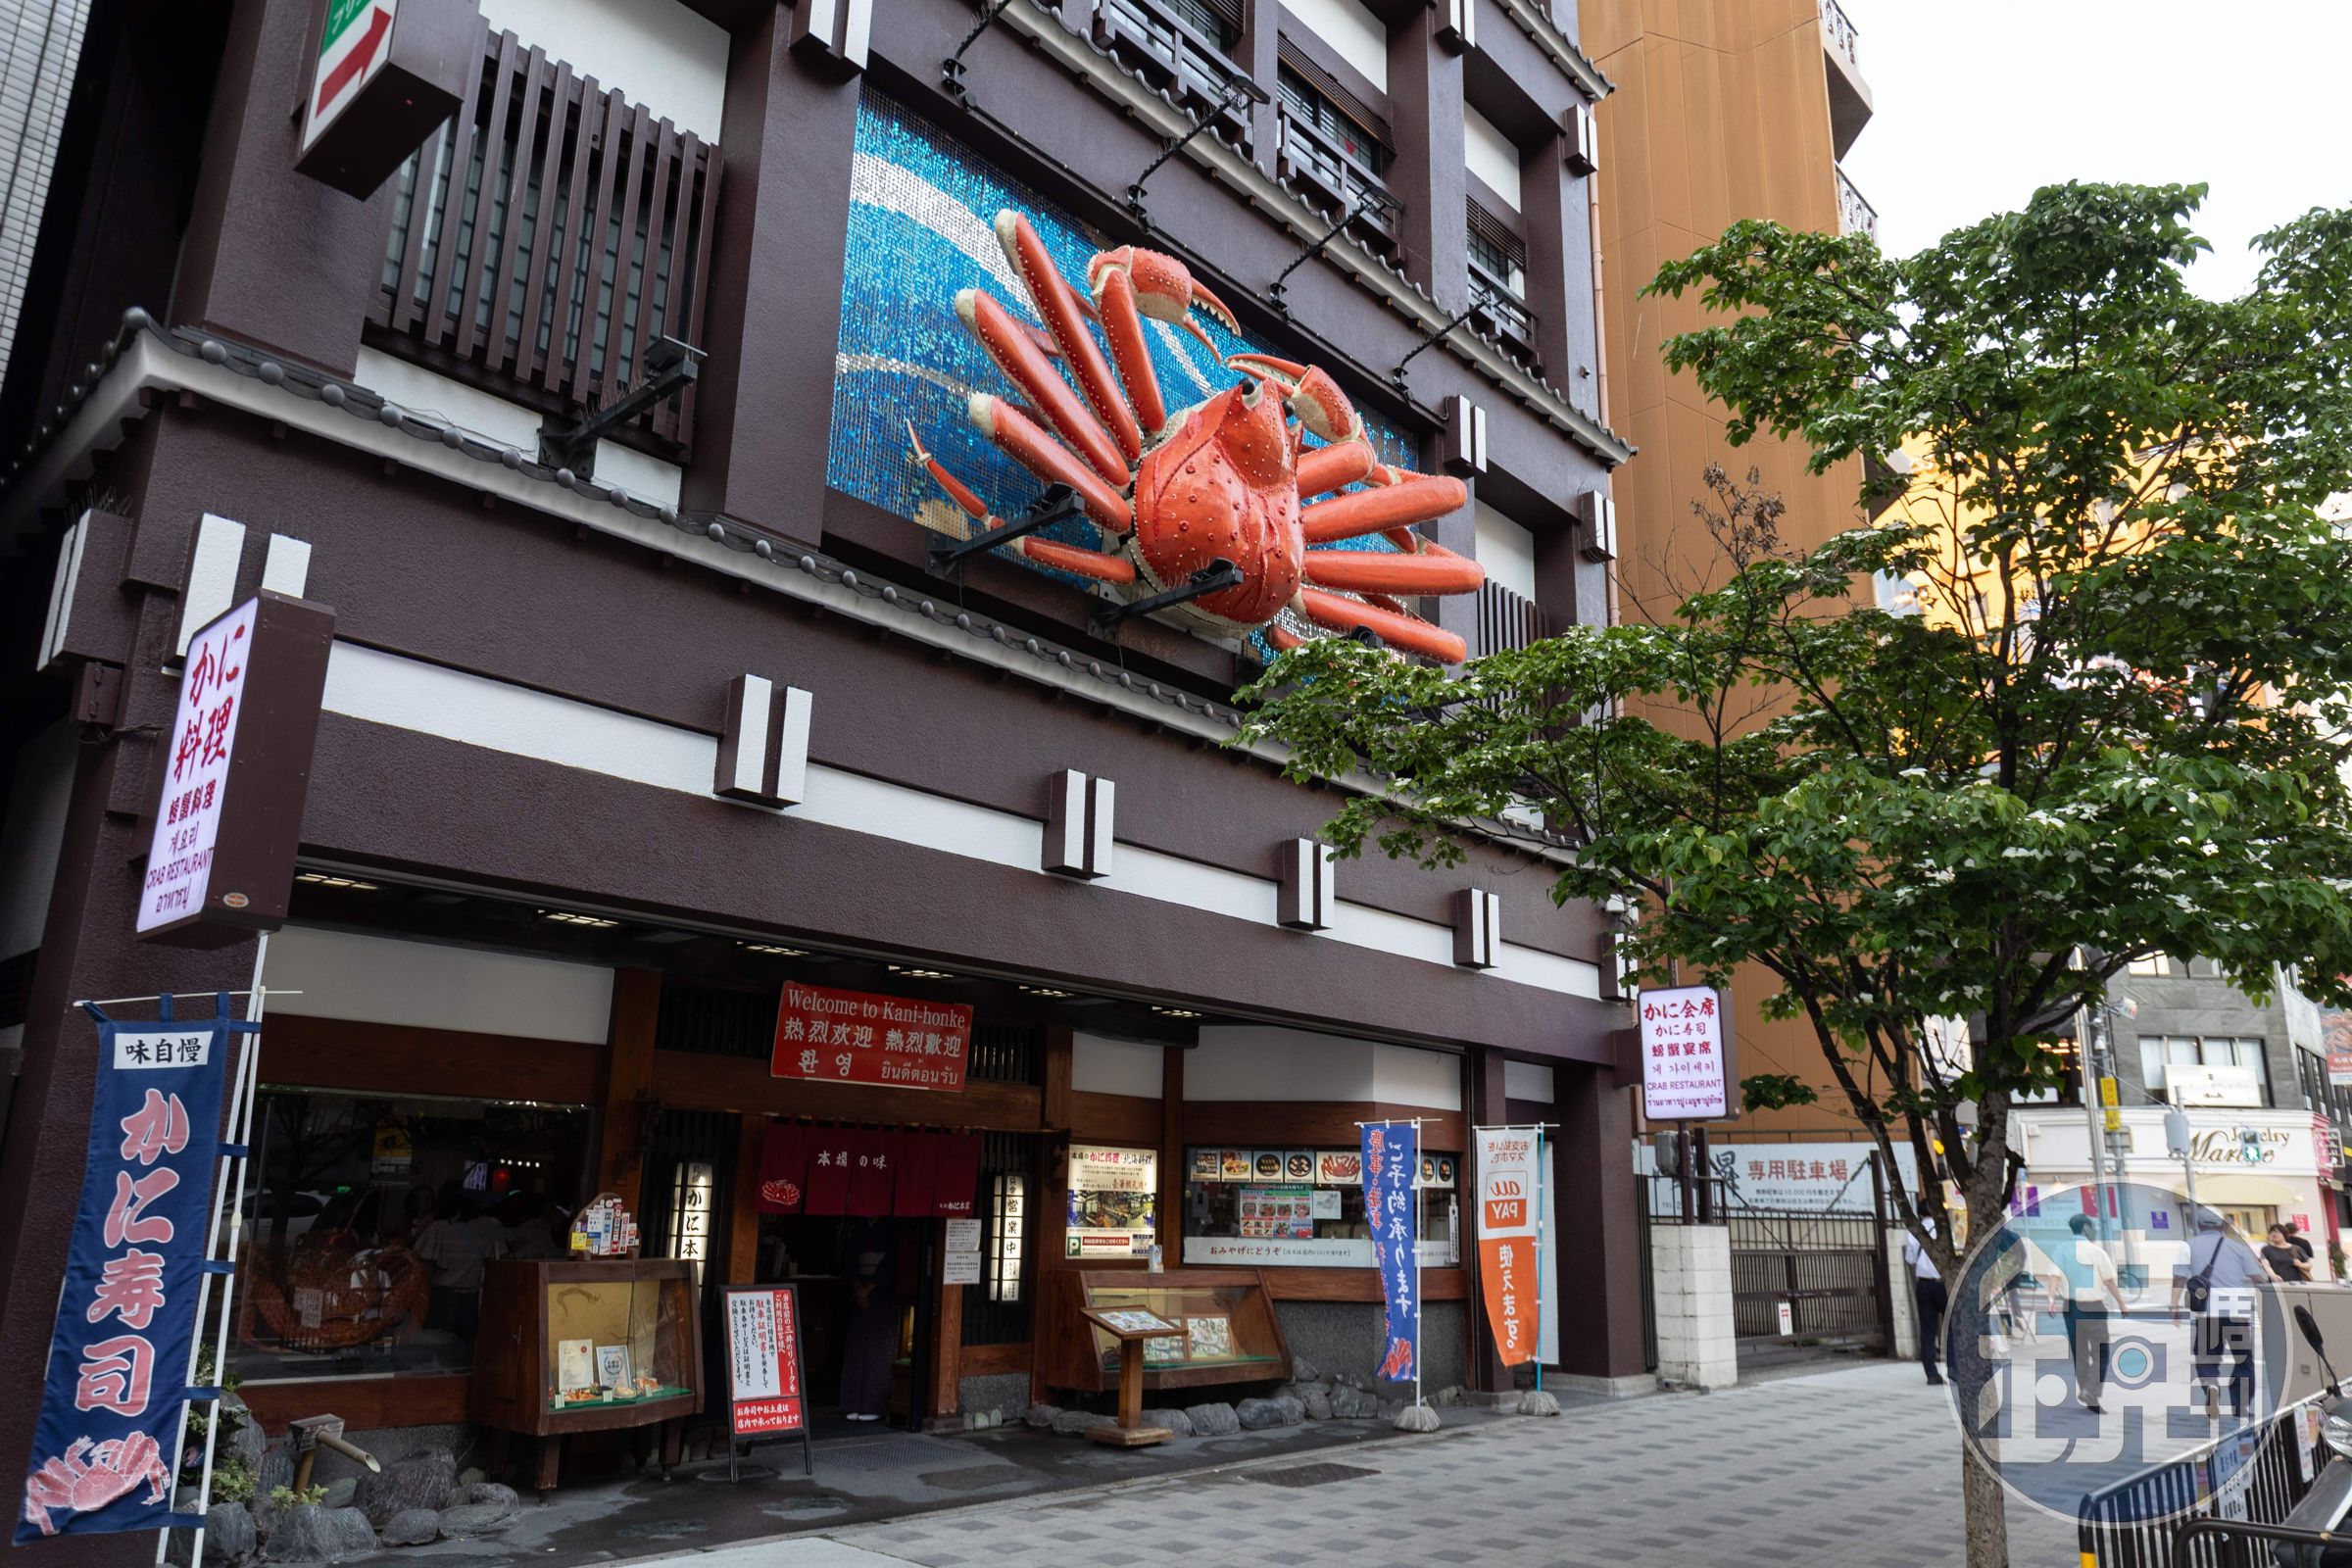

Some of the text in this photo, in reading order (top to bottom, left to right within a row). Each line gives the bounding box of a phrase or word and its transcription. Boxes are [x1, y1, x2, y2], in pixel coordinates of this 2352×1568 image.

[146, 847, 215, 890] CRAB RESTAURANT
[788, 989, 965, 1029] Welcome to Kani-honke
[1643, 997, 1715, 1021] かに会席
[784, 1016, 962, 1058] 热烈欢迎 熱烈歡迎
[1655, 1021, 1706, 1038] かに寿司
[125, 1037, 203, 1065] 味自慢
[1646, 1079, 1722, 1091] CRAB RESTAURANT
[2230, 1127, 2290, 1147] Jeelry
[1747, 1159, 1848, 1182] 専用駐車場
[74, 1087, 190, 1417] かに寿司
[1209, 1246, 1282, 1256] おみやげにどうぞ
